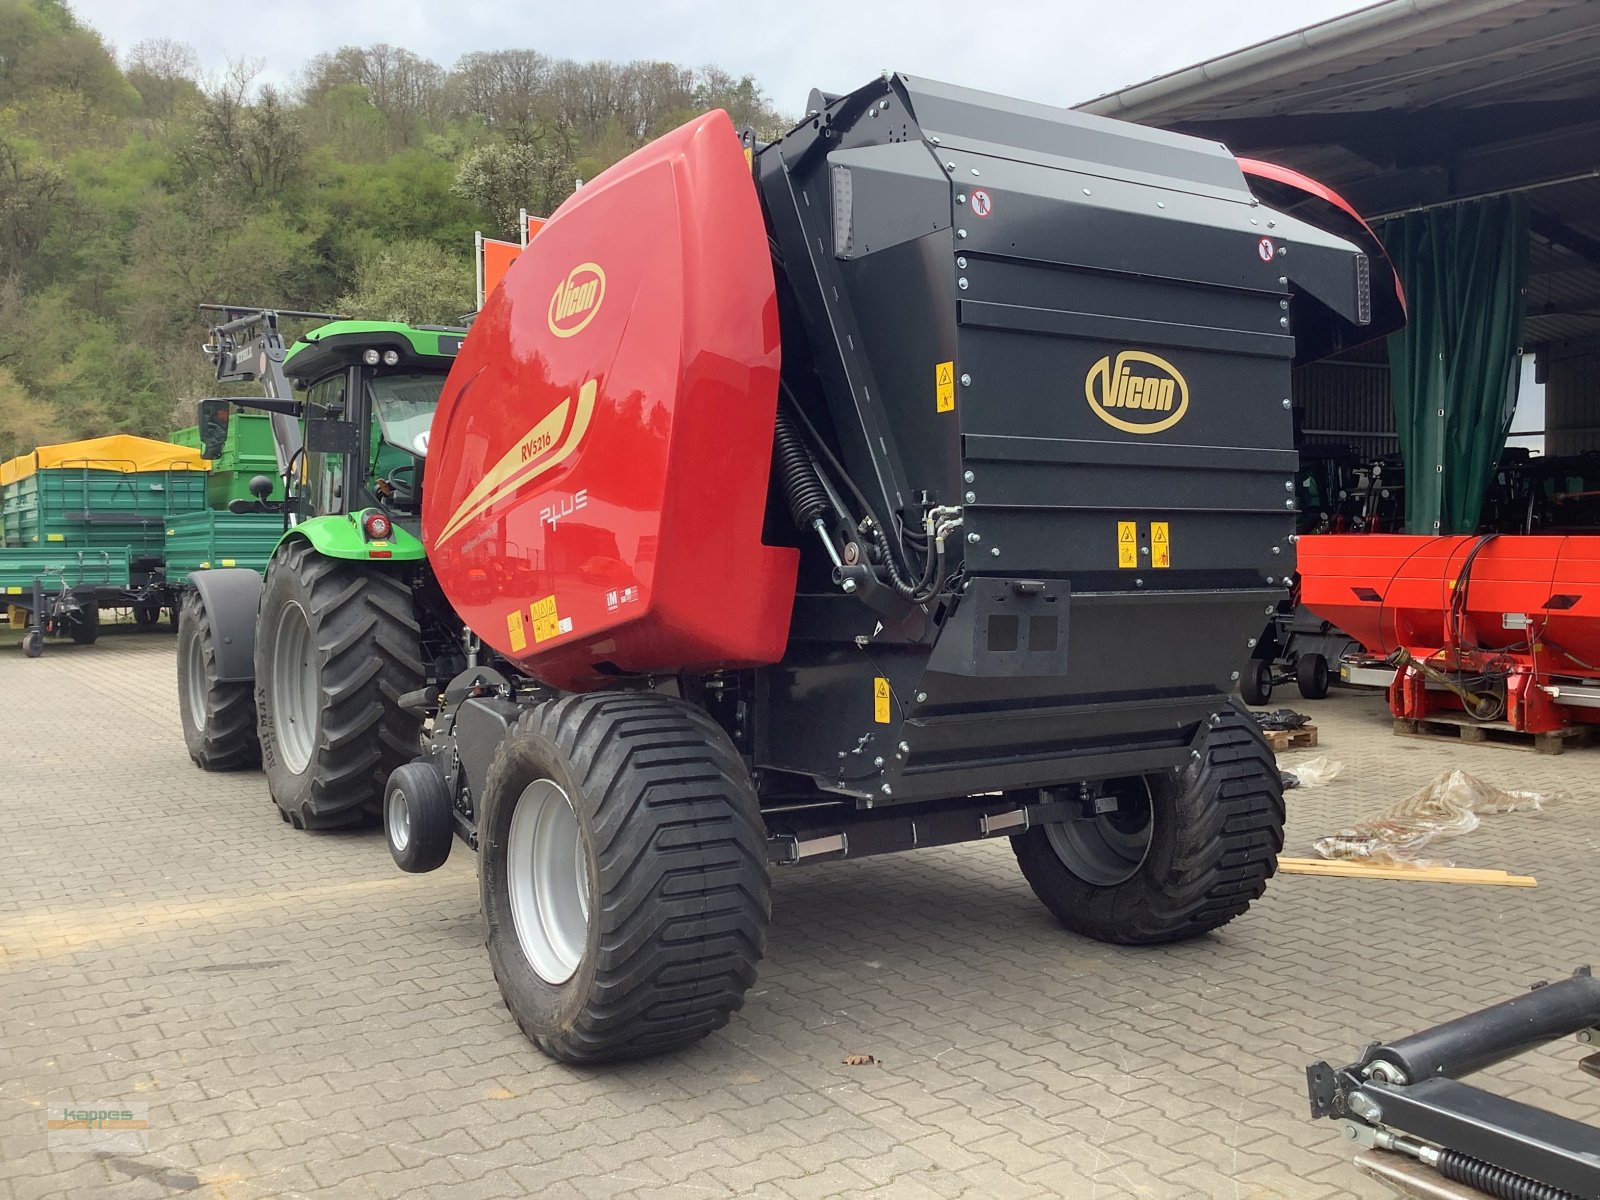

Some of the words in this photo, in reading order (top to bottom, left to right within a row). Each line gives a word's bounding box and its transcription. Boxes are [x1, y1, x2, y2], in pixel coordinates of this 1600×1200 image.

[554, 278, 599, 322] Vicon
[1101, 354, 1175, 411] Vicon
[521, 431, 551, 463] RV5216
[539, 488, 588, 532] PLUS
